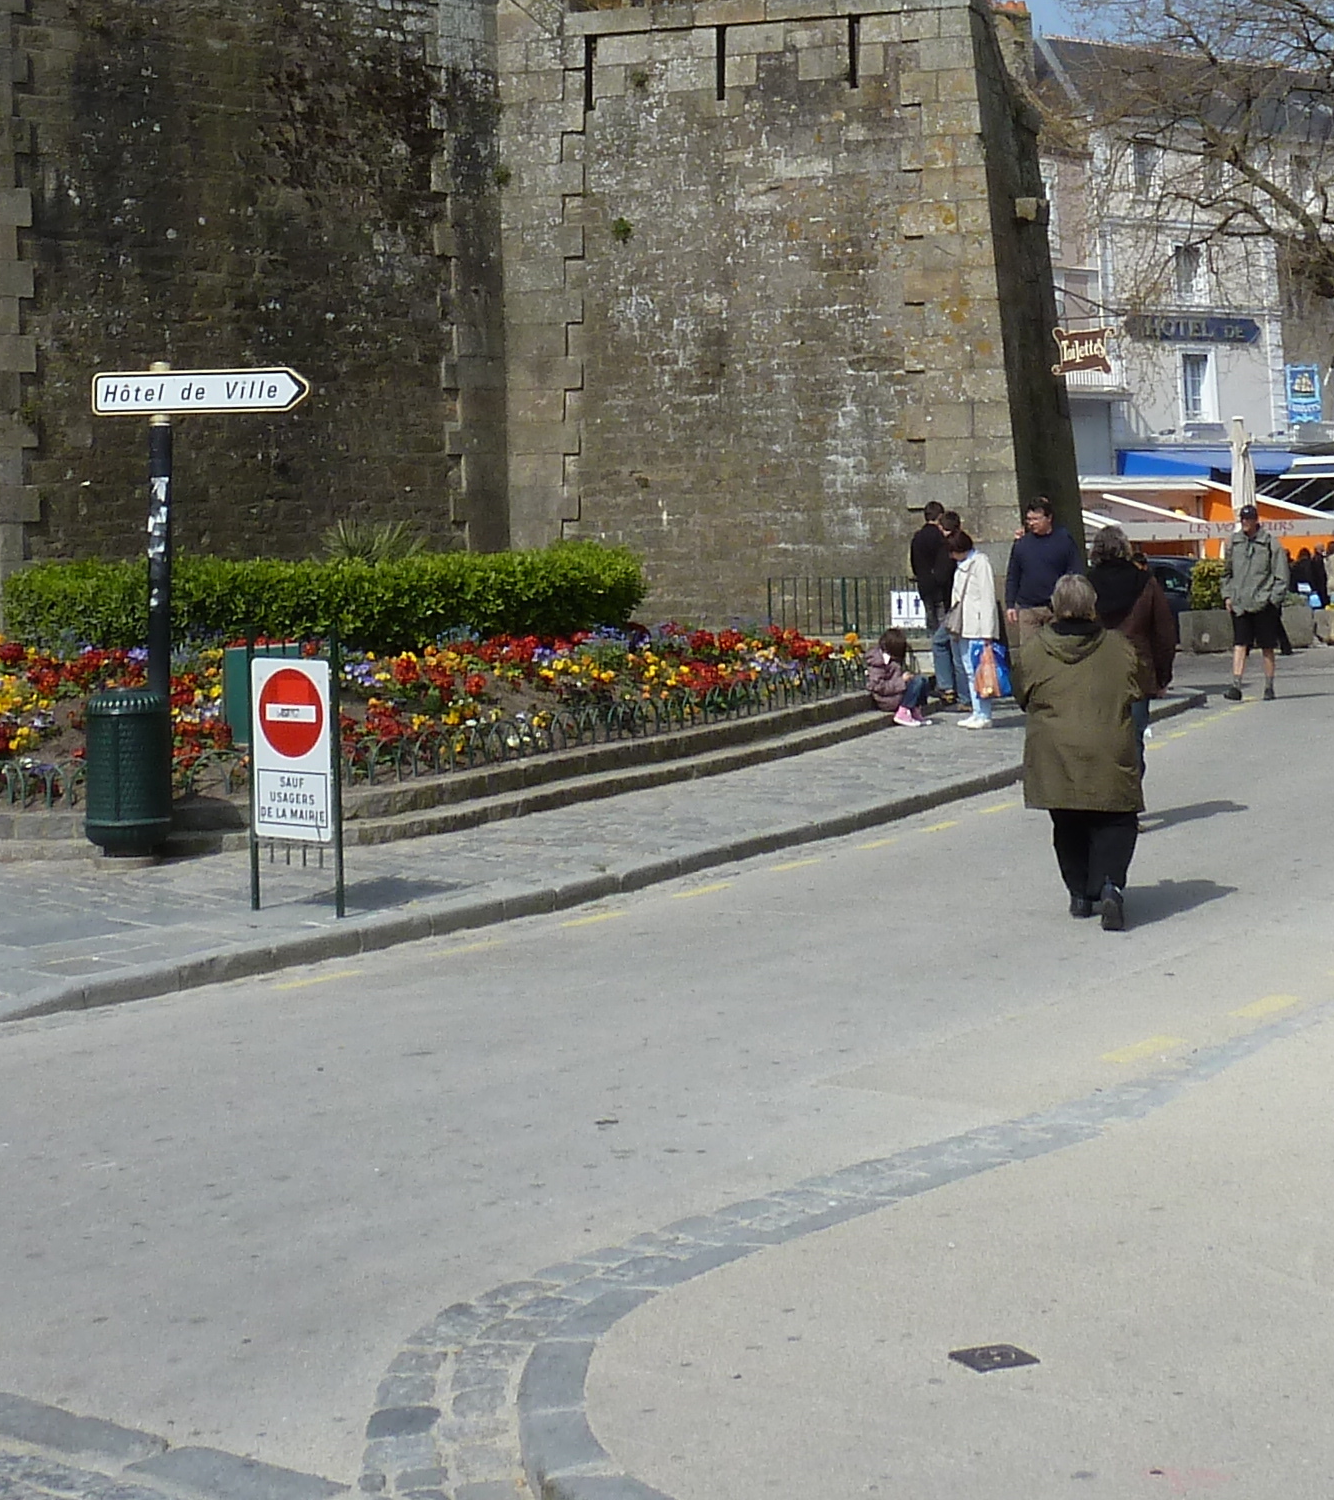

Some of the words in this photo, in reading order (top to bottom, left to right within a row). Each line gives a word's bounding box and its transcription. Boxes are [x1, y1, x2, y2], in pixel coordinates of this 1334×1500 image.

[1223, 325, 1245, 338] DE
[1061, 338, 1106, 363] Toilettes
[103, 383, 165, 403] Hôtel
[180, 382, 206, 401] de
[225, 380, 278, 400] Ville
[1188, 523, 1211, 534] LES
[279, 776, 305, 789] SAUF
[269, 791, 315, 806] USAGERS
[260, 806, 273, 818] DE
[276, 807, 287, 820] LA
[290, 808, 325, 823] MAIRIE
